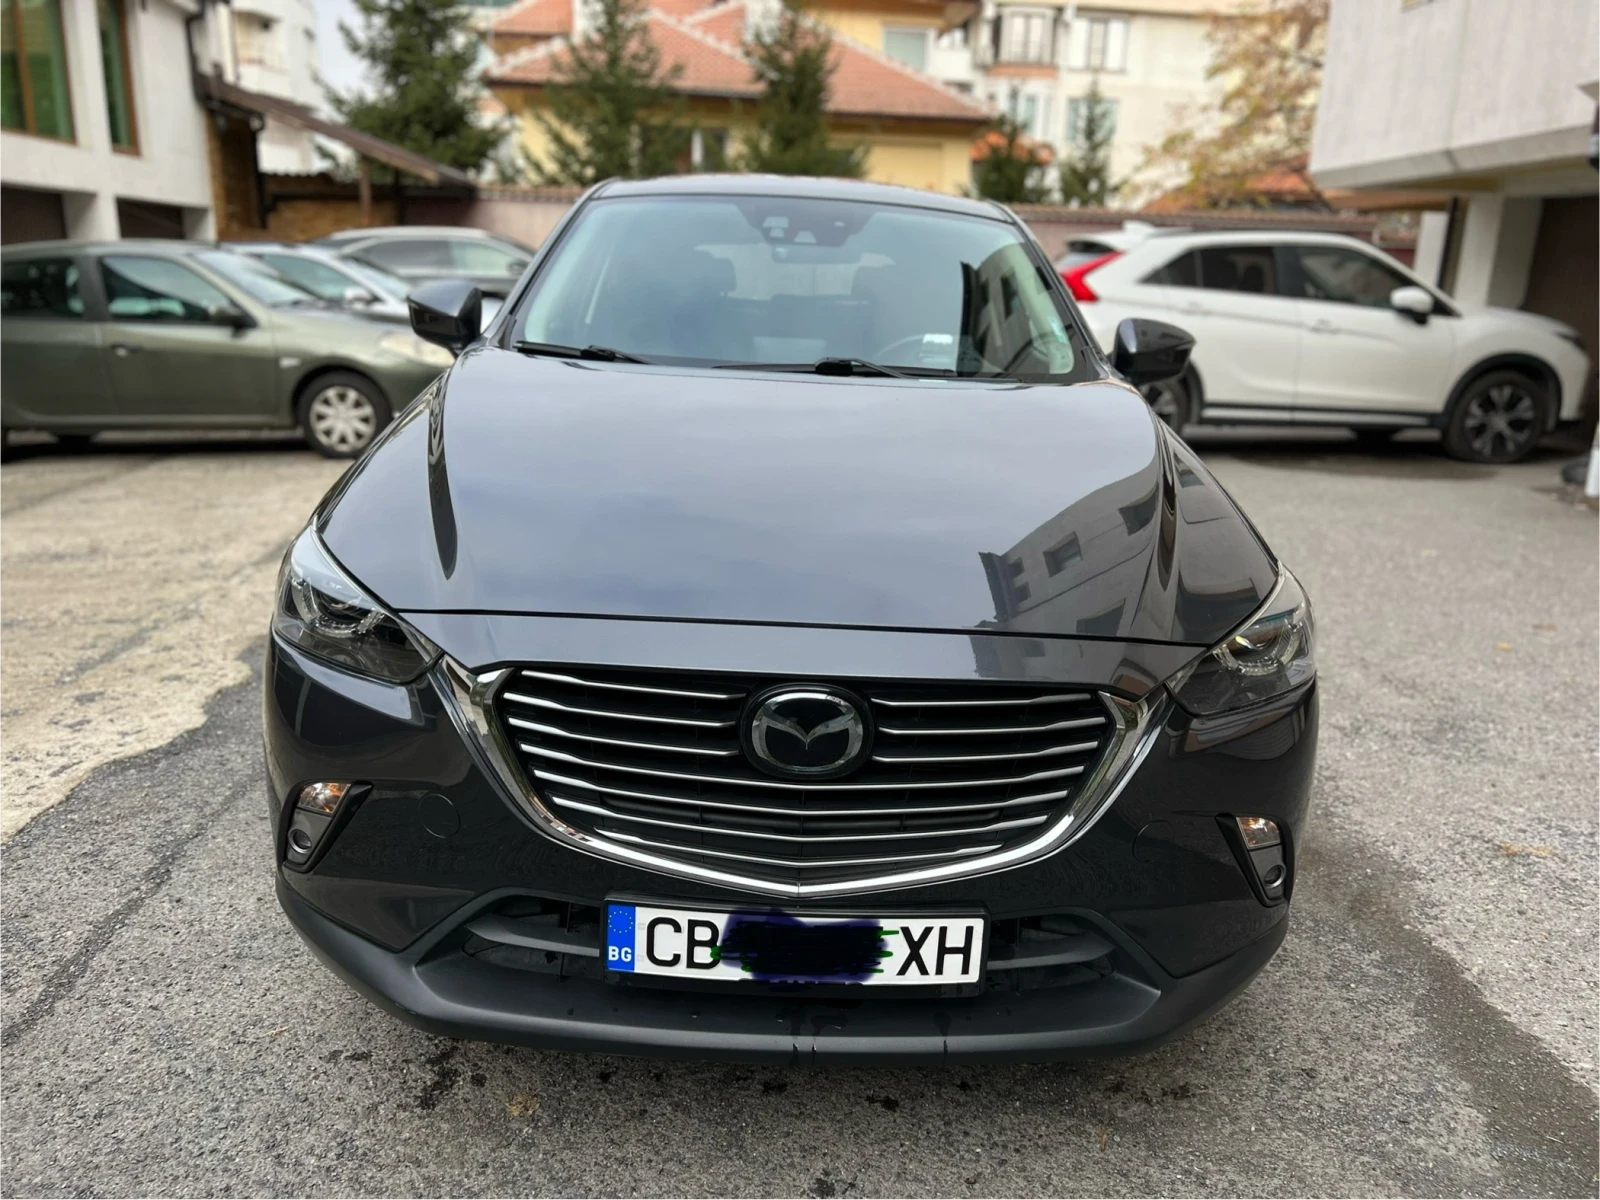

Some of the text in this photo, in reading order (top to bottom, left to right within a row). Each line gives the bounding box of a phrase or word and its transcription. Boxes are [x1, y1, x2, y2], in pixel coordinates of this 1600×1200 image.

[608, 945, 633, 963] BG
[646, 917, 720, 970] CB
[896, 926, 974, 976] XH
